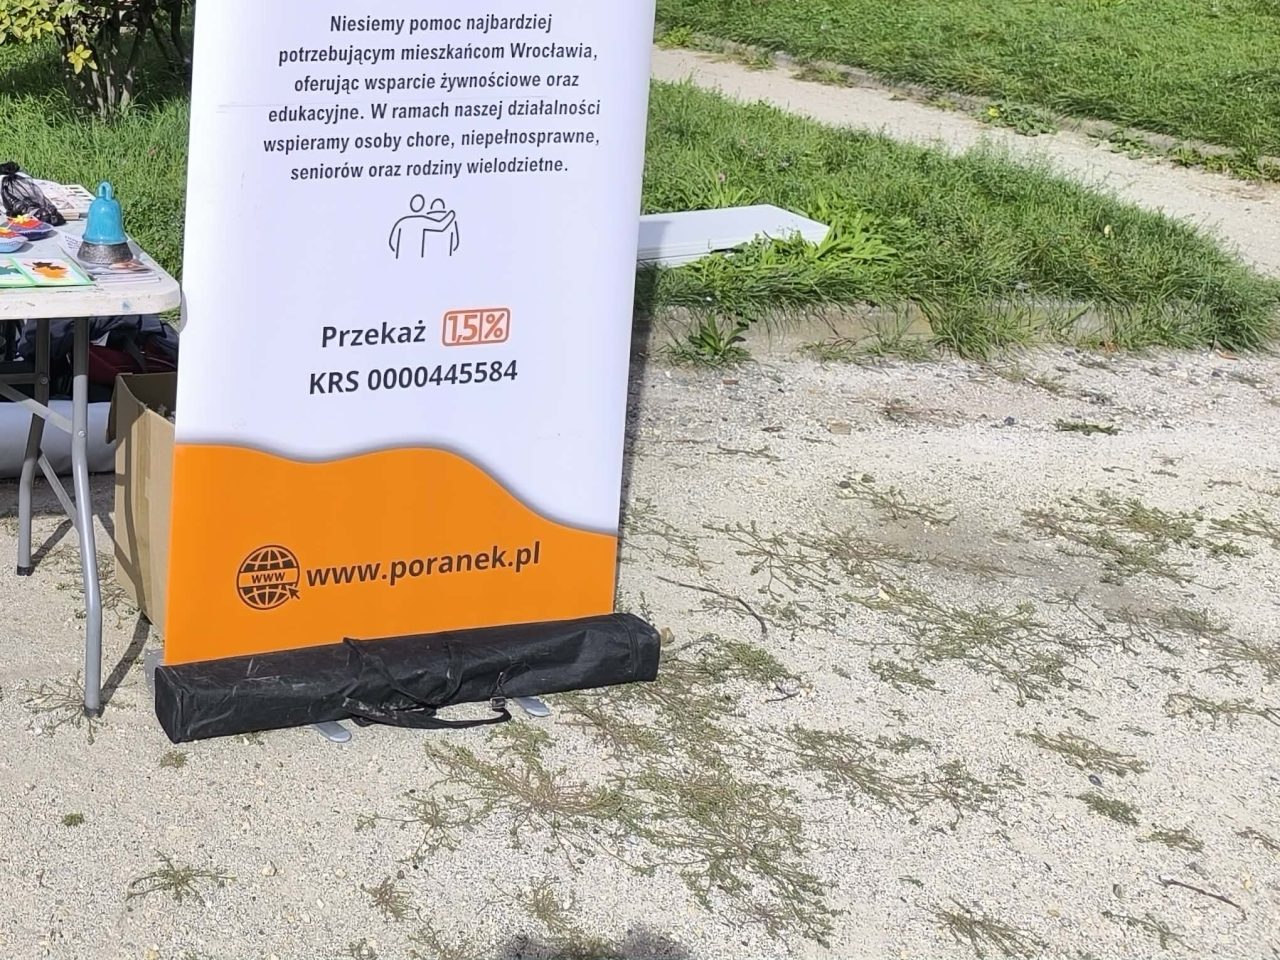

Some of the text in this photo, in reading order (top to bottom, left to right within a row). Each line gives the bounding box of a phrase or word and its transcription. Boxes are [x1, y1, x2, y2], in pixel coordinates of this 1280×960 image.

[331, 14, 552, 34] Niesiemy pomoc najbardziej
[279, 43, 597, 66] potrzebującym mieszkańcom Wrocławia,
[295, 72, 579, 94] oferując wsparcie żywnościowe oraz
[268, 100, 600, 124] edukacyjne. W ramach naszej działalności
[264, 129, 599, 154] wspieramy osoby chore, niepełnosprawne,
[291, 158, 568, 180] seniorów oraz rodziny wielodzietne.
[322, 312, 504, 347] Przekaż 1,5%
[309, 360, 517, 394] KRS 0000445584
[306, 541, 540, 586] www.poranek.pl
[251, 571, 285, 584] www
